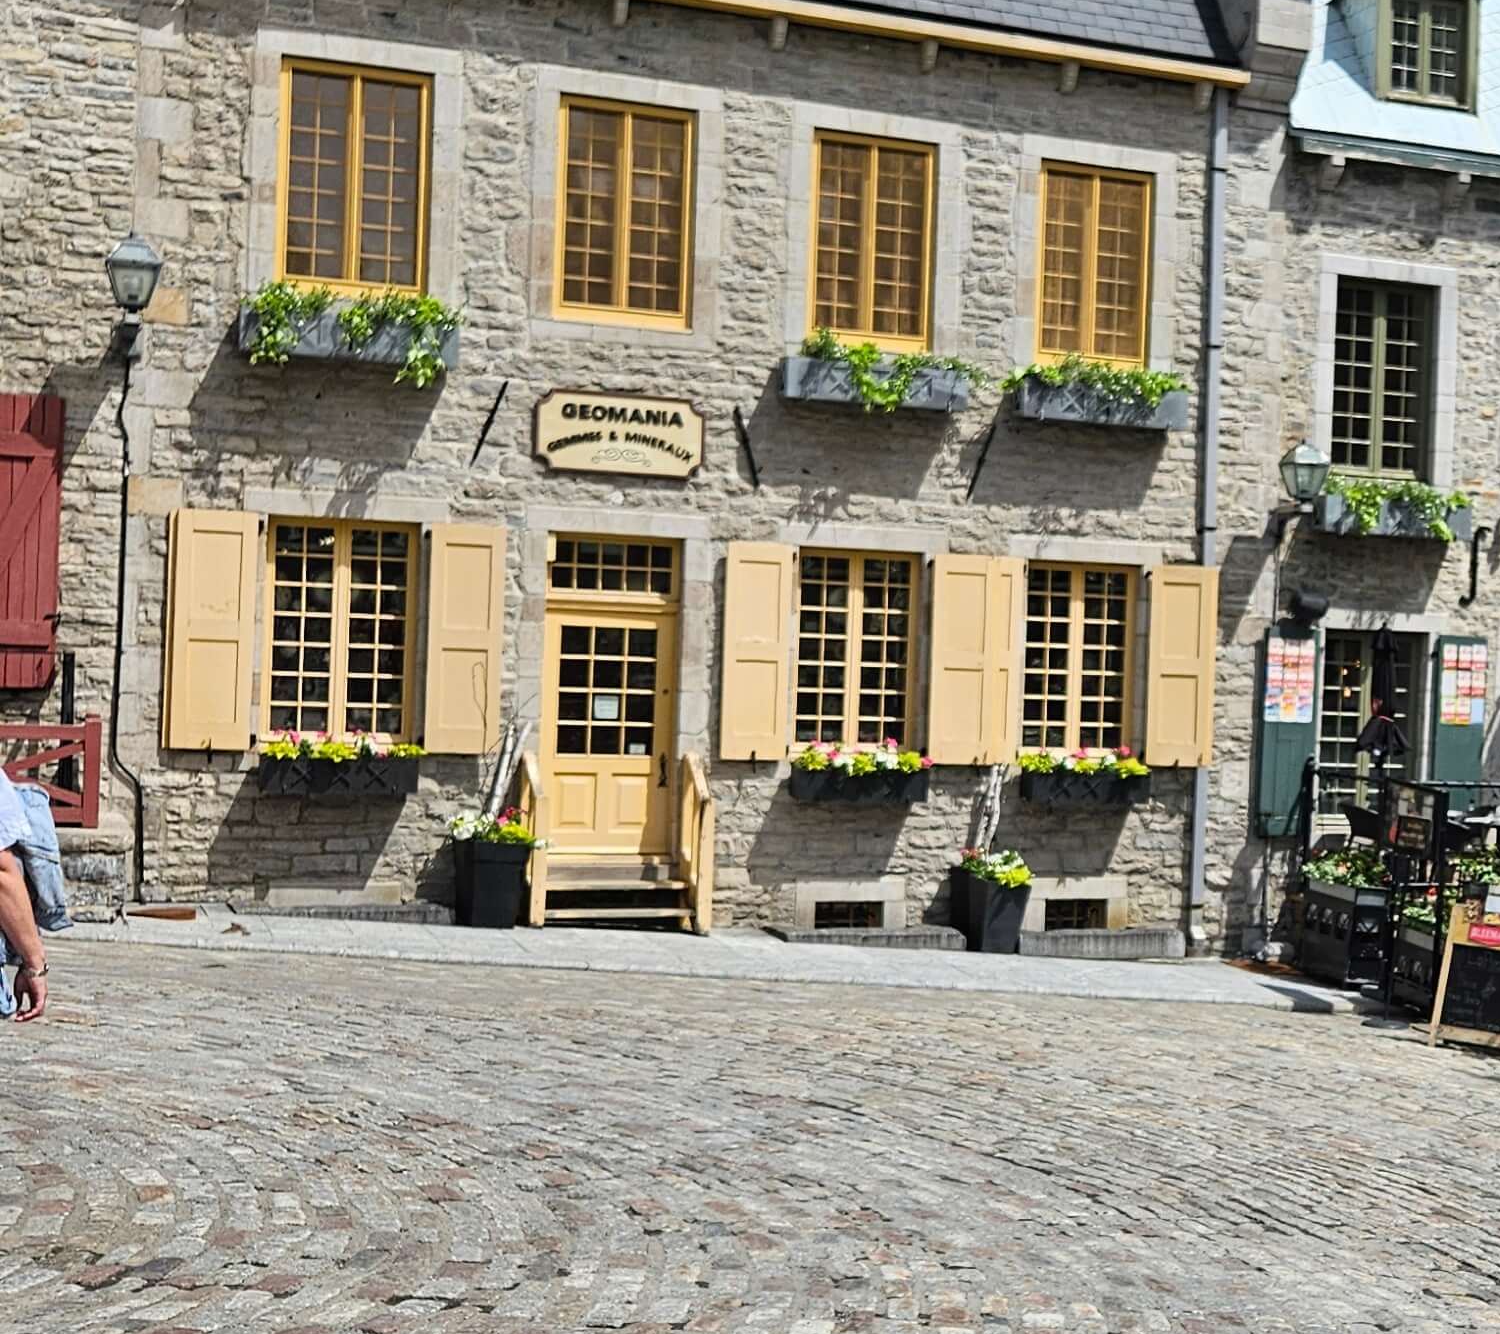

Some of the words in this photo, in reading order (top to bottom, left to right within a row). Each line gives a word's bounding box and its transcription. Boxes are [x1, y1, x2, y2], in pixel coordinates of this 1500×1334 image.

[561, 403, 684, 429] GEOMANIA
[546, 431, 603, 453] GEMMES
[608, 430, 618, 442] &
[624, 432, 695, 464] MINERAUX
